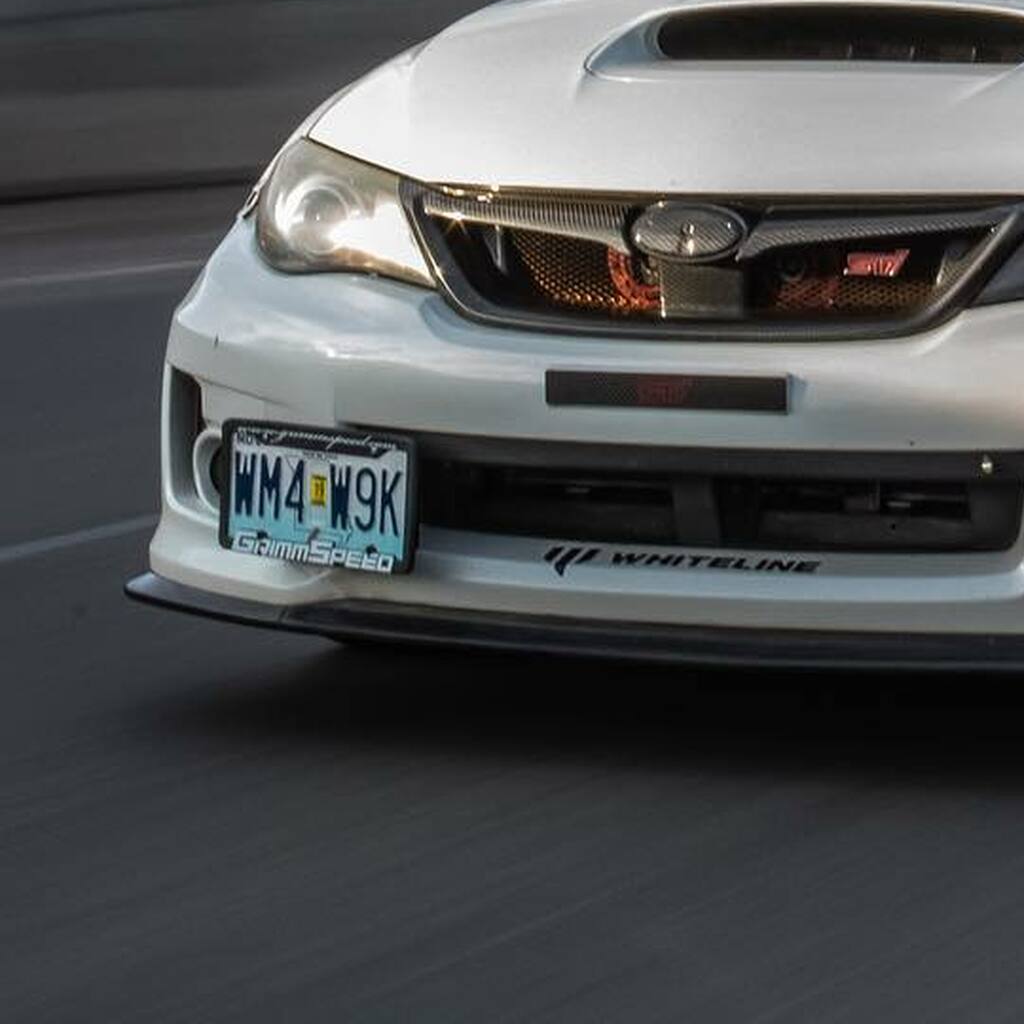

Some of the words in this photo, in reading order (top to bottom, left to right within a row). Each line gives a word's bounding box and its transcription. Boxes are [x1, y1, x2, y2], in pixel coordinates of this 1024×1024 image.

[234, 451, 304, 524] WM4
[330, 463, 403, 537] W9K
[612, 552, 823, 573] WHITELINE
